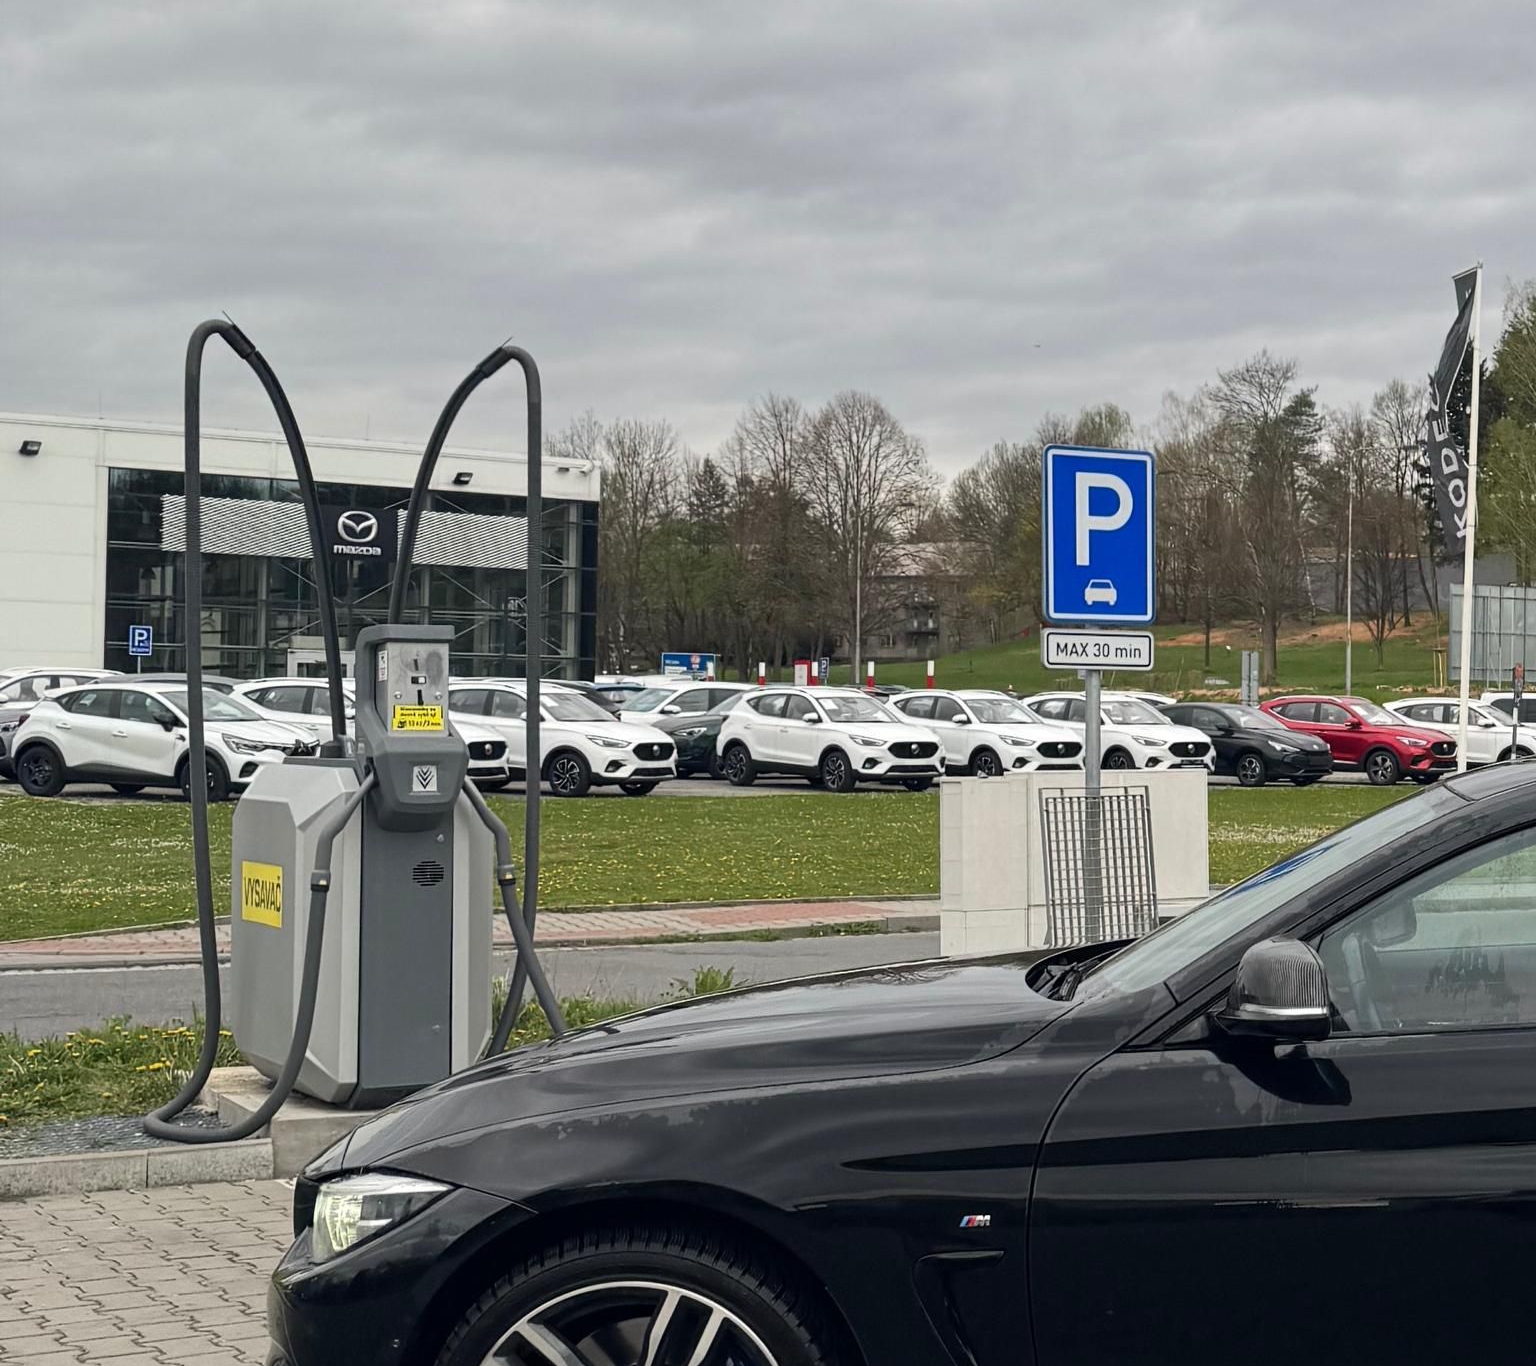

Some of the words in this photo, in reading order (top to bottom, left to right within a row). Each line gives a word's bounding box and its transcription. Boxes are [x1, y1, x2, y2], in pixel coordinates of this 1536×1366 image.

[1075, 471, 1134, 566] P
[134, 629, 148, 646] P
[1056, 642, 1089, 657] MAX
[1093, 643, 1110, 658] 30
[1115, 643, 1142, 659] min
[243, 875, 282, 913] VYSAVAČ
